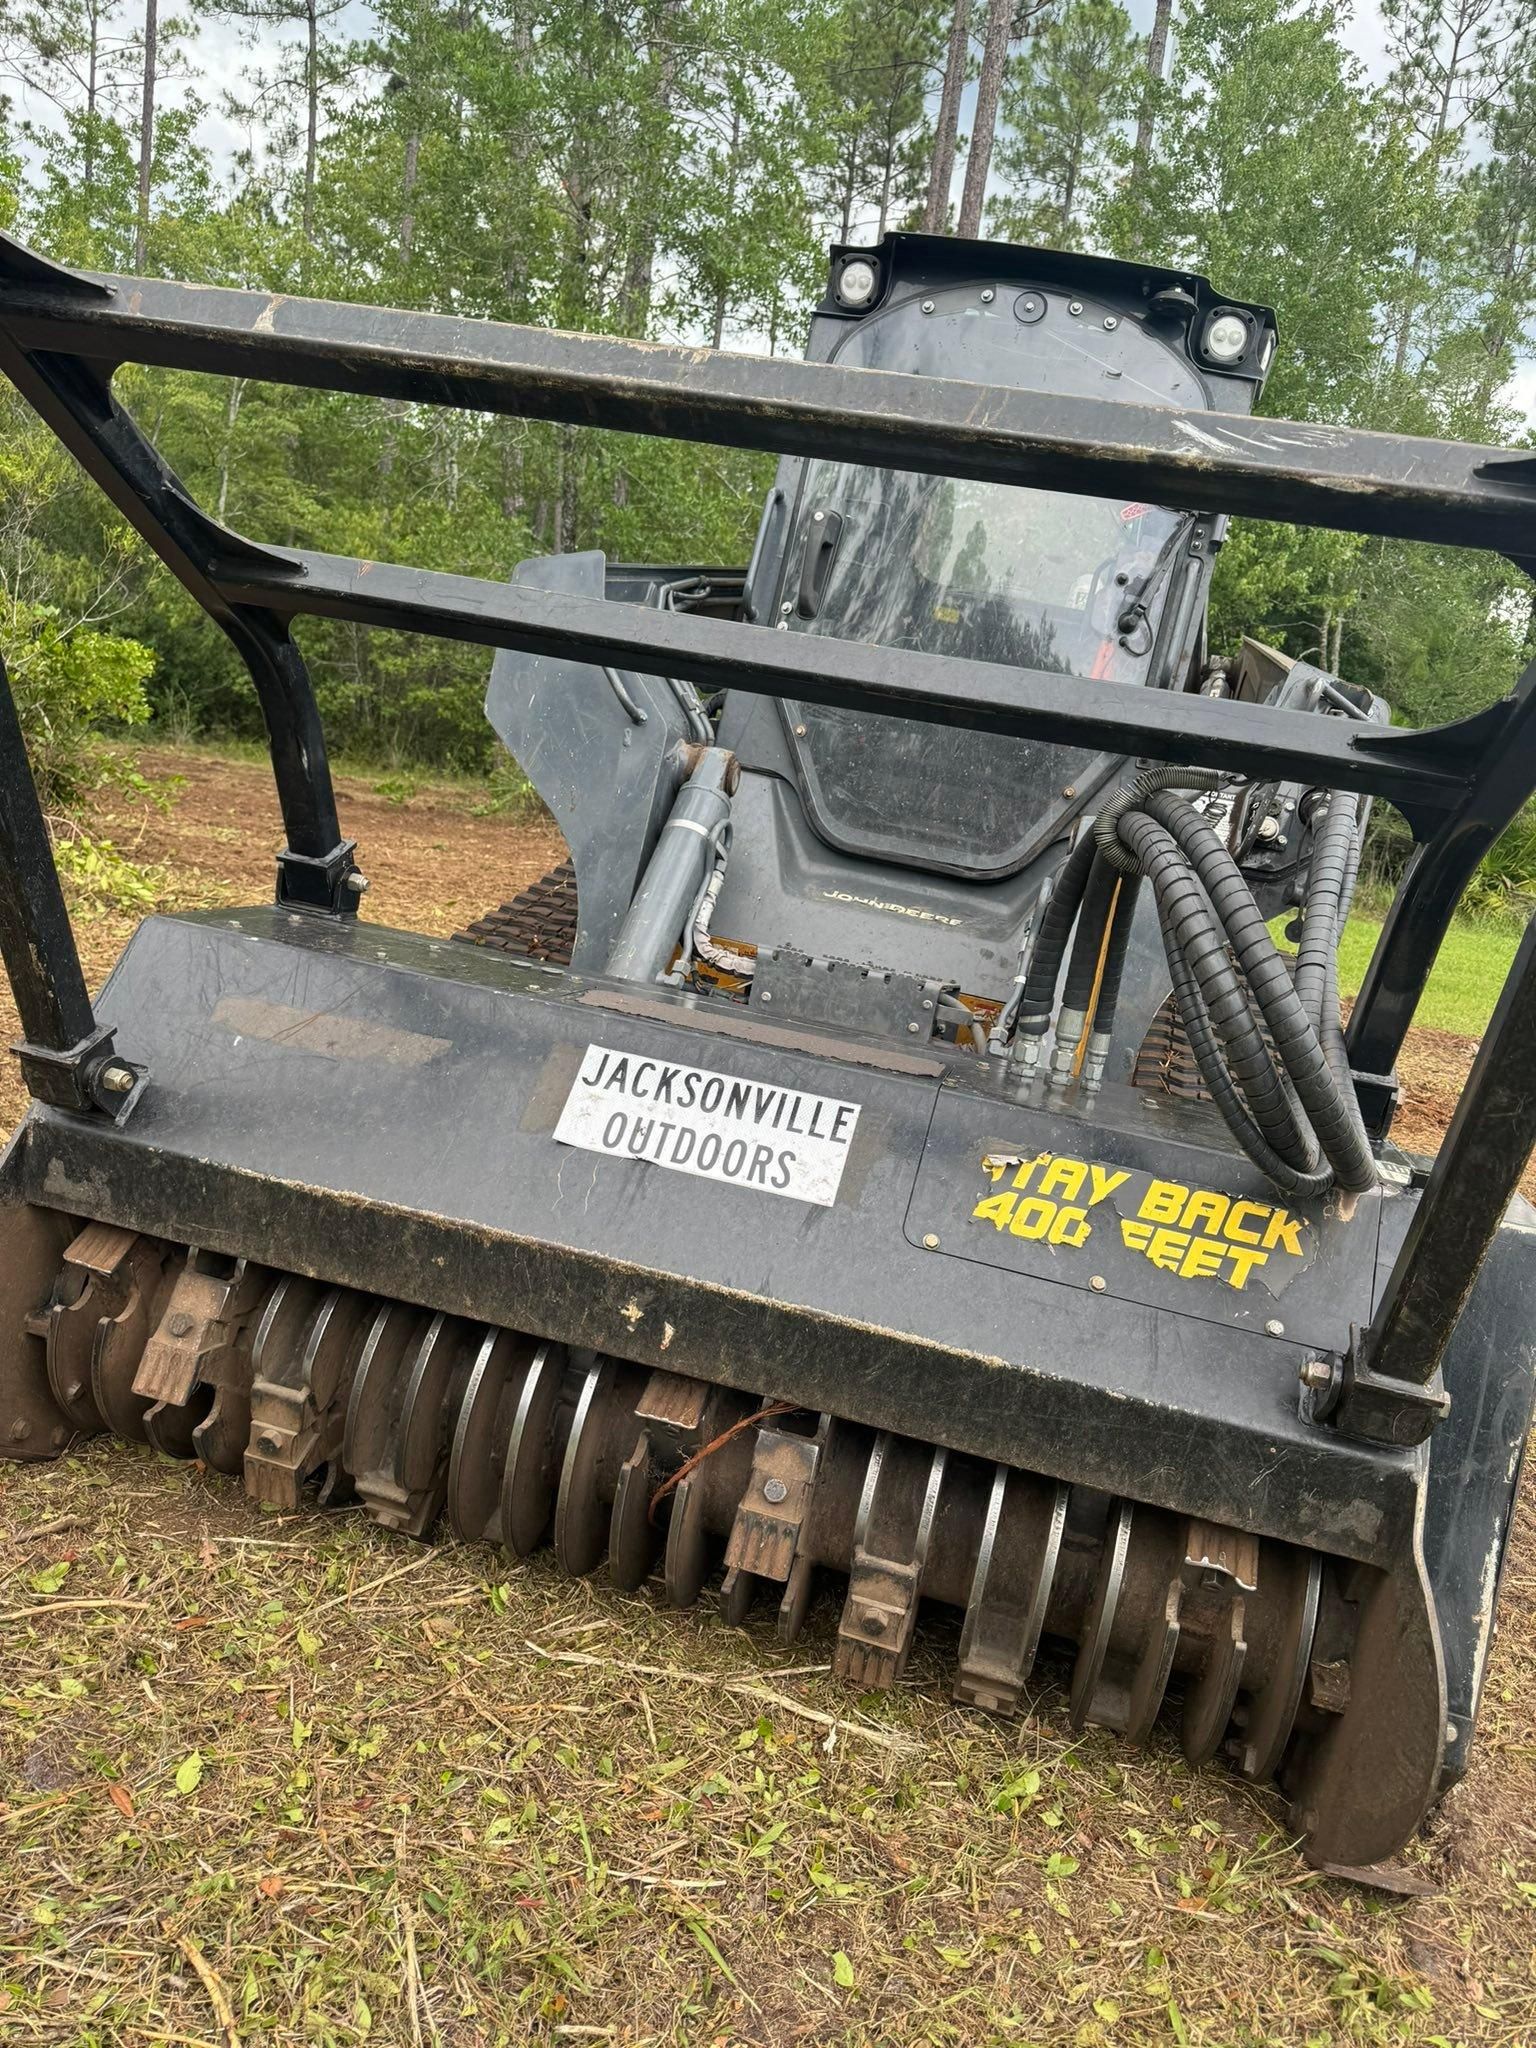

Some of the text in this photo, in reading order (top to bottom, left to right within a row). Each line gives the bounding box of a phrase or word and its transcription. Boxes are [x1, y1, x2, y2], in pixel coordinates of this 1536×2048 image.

[884, 903, 964, 926] DEERE
[582, 1053, 855, 1145] JACKSONVILLE
[602, 1111, 797, 1189] OUTDOORS
[973, 1191, 1269, 1290] 400 FEET
[1137, 1178, 1304, 1256] BACK
